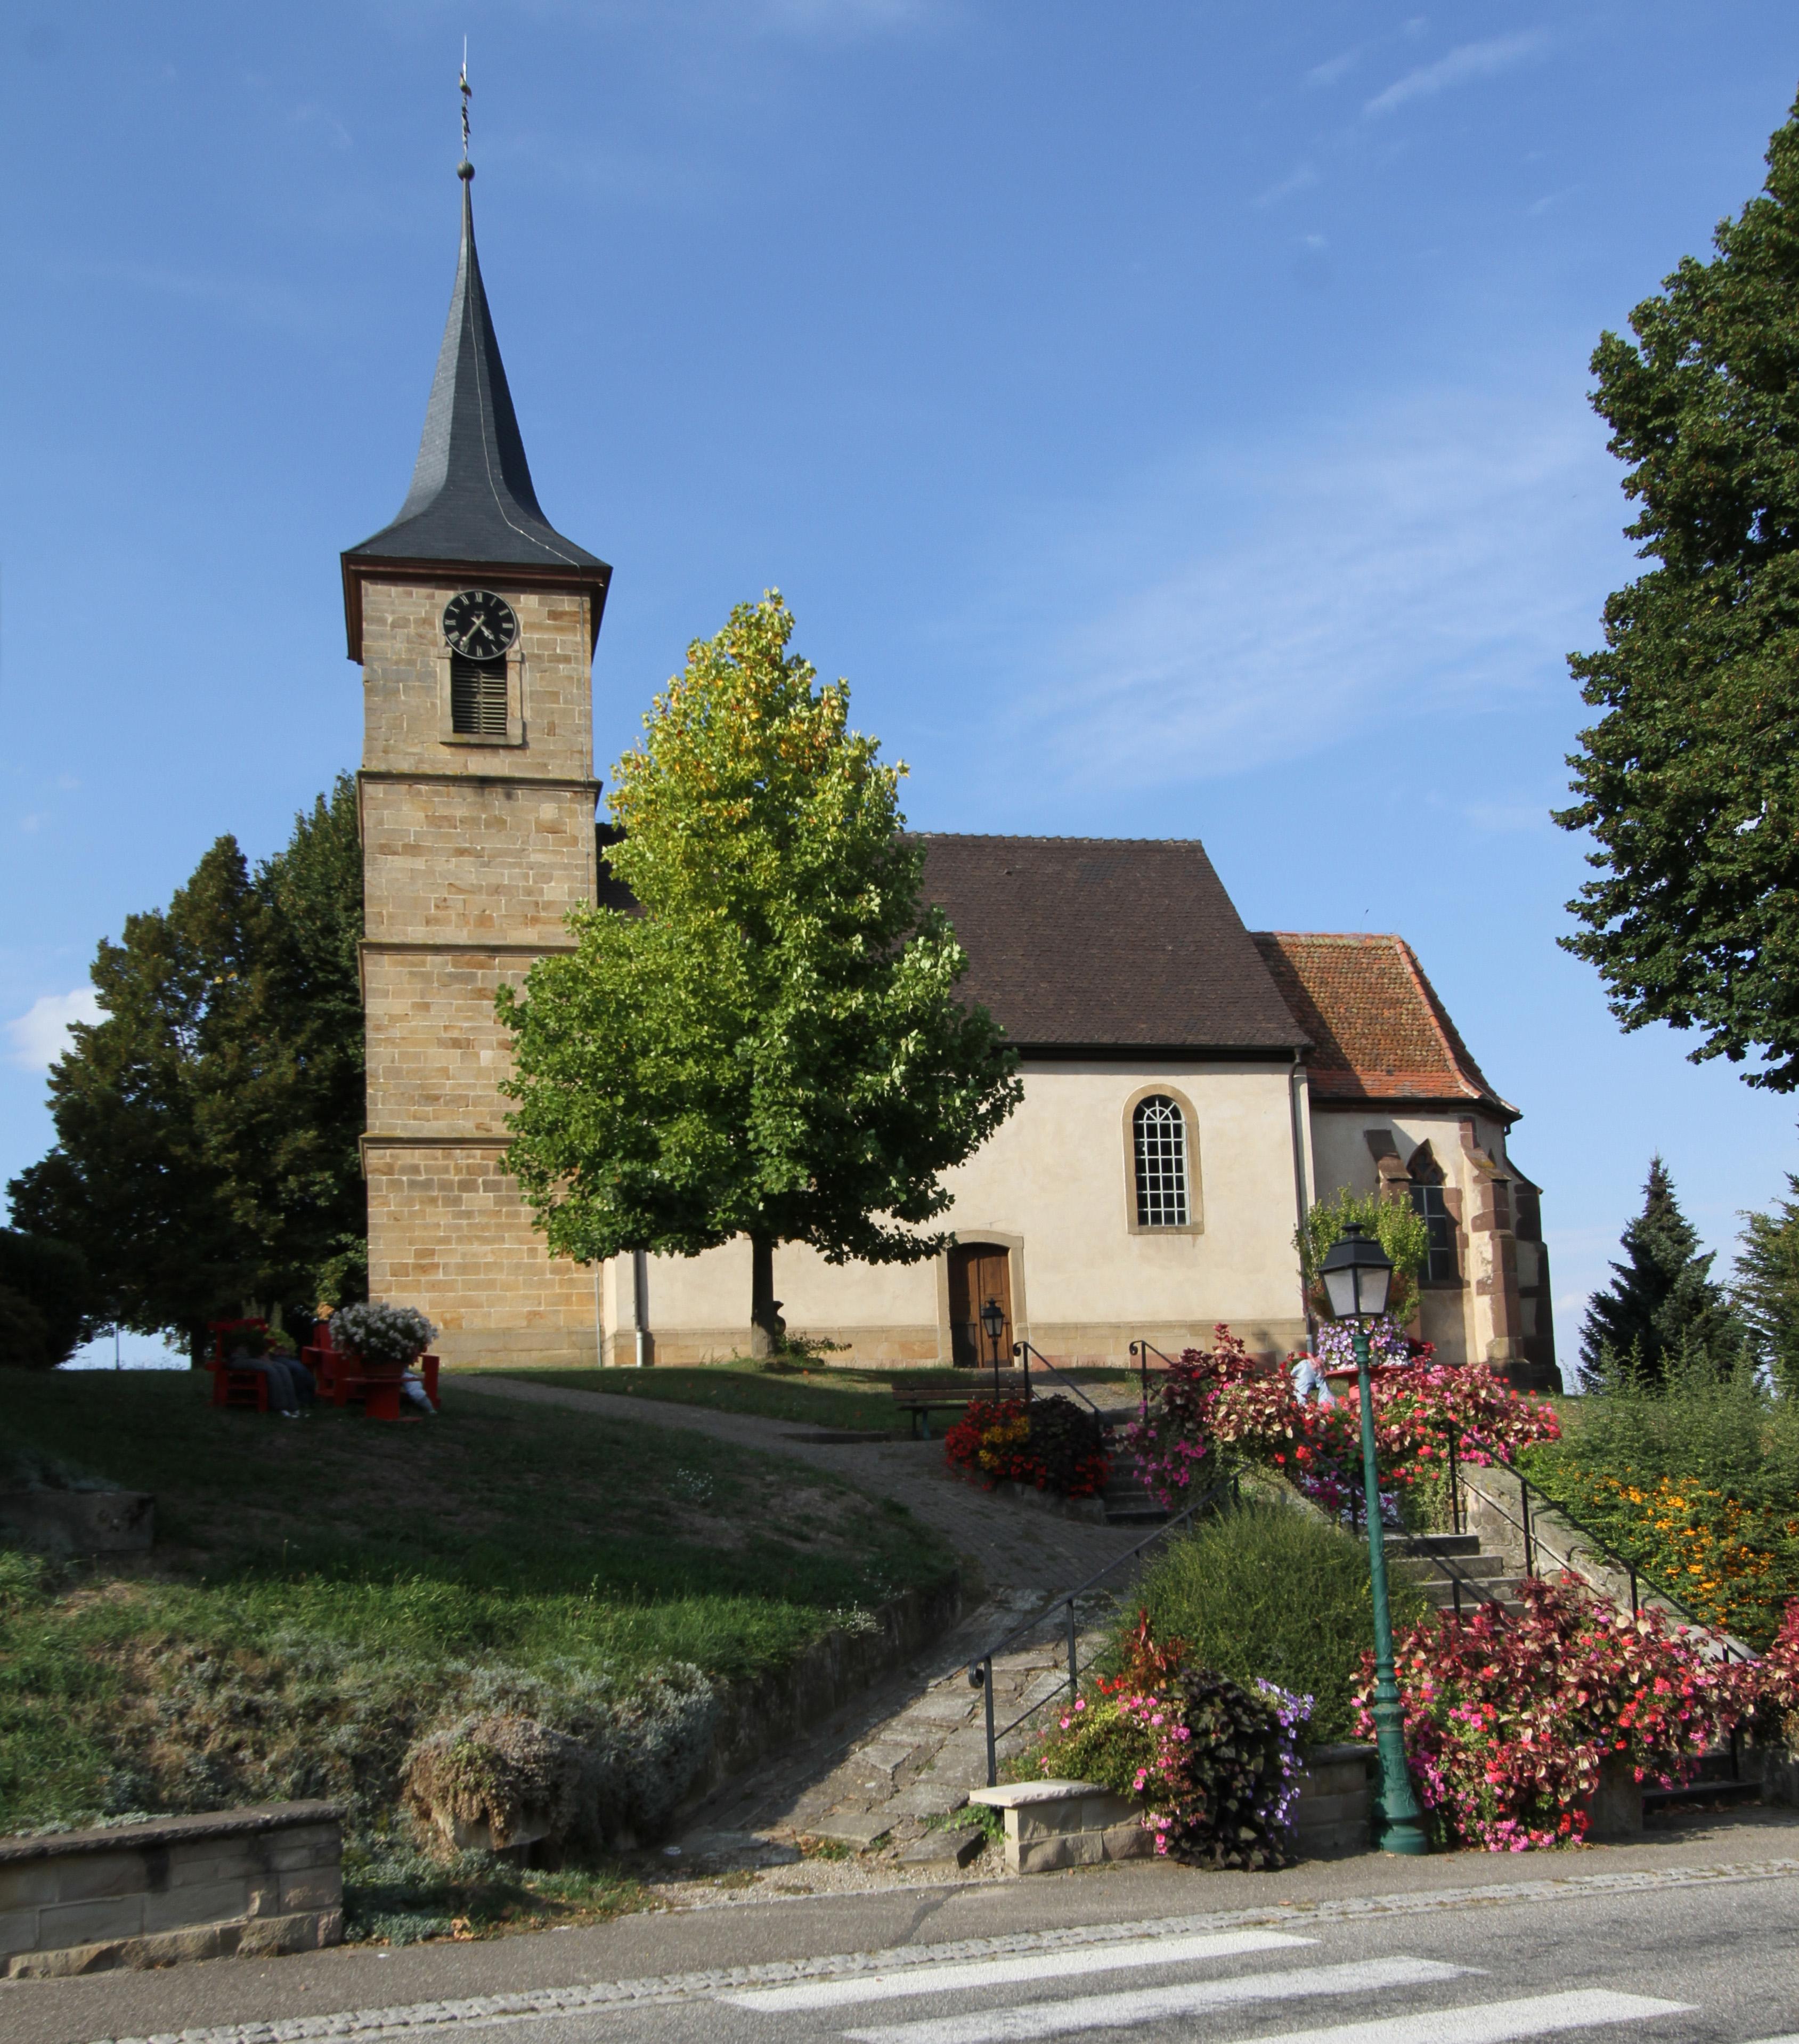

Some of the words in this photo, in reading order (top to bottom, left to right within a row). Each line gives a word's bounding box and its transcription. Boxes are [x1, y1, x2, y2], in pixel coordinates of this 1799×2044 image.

[459, 595, 469, 605] XI
[490, 597, 496, 606] I
[449, 605, 459, 613] X
[476, 645, 483, 656] VI
